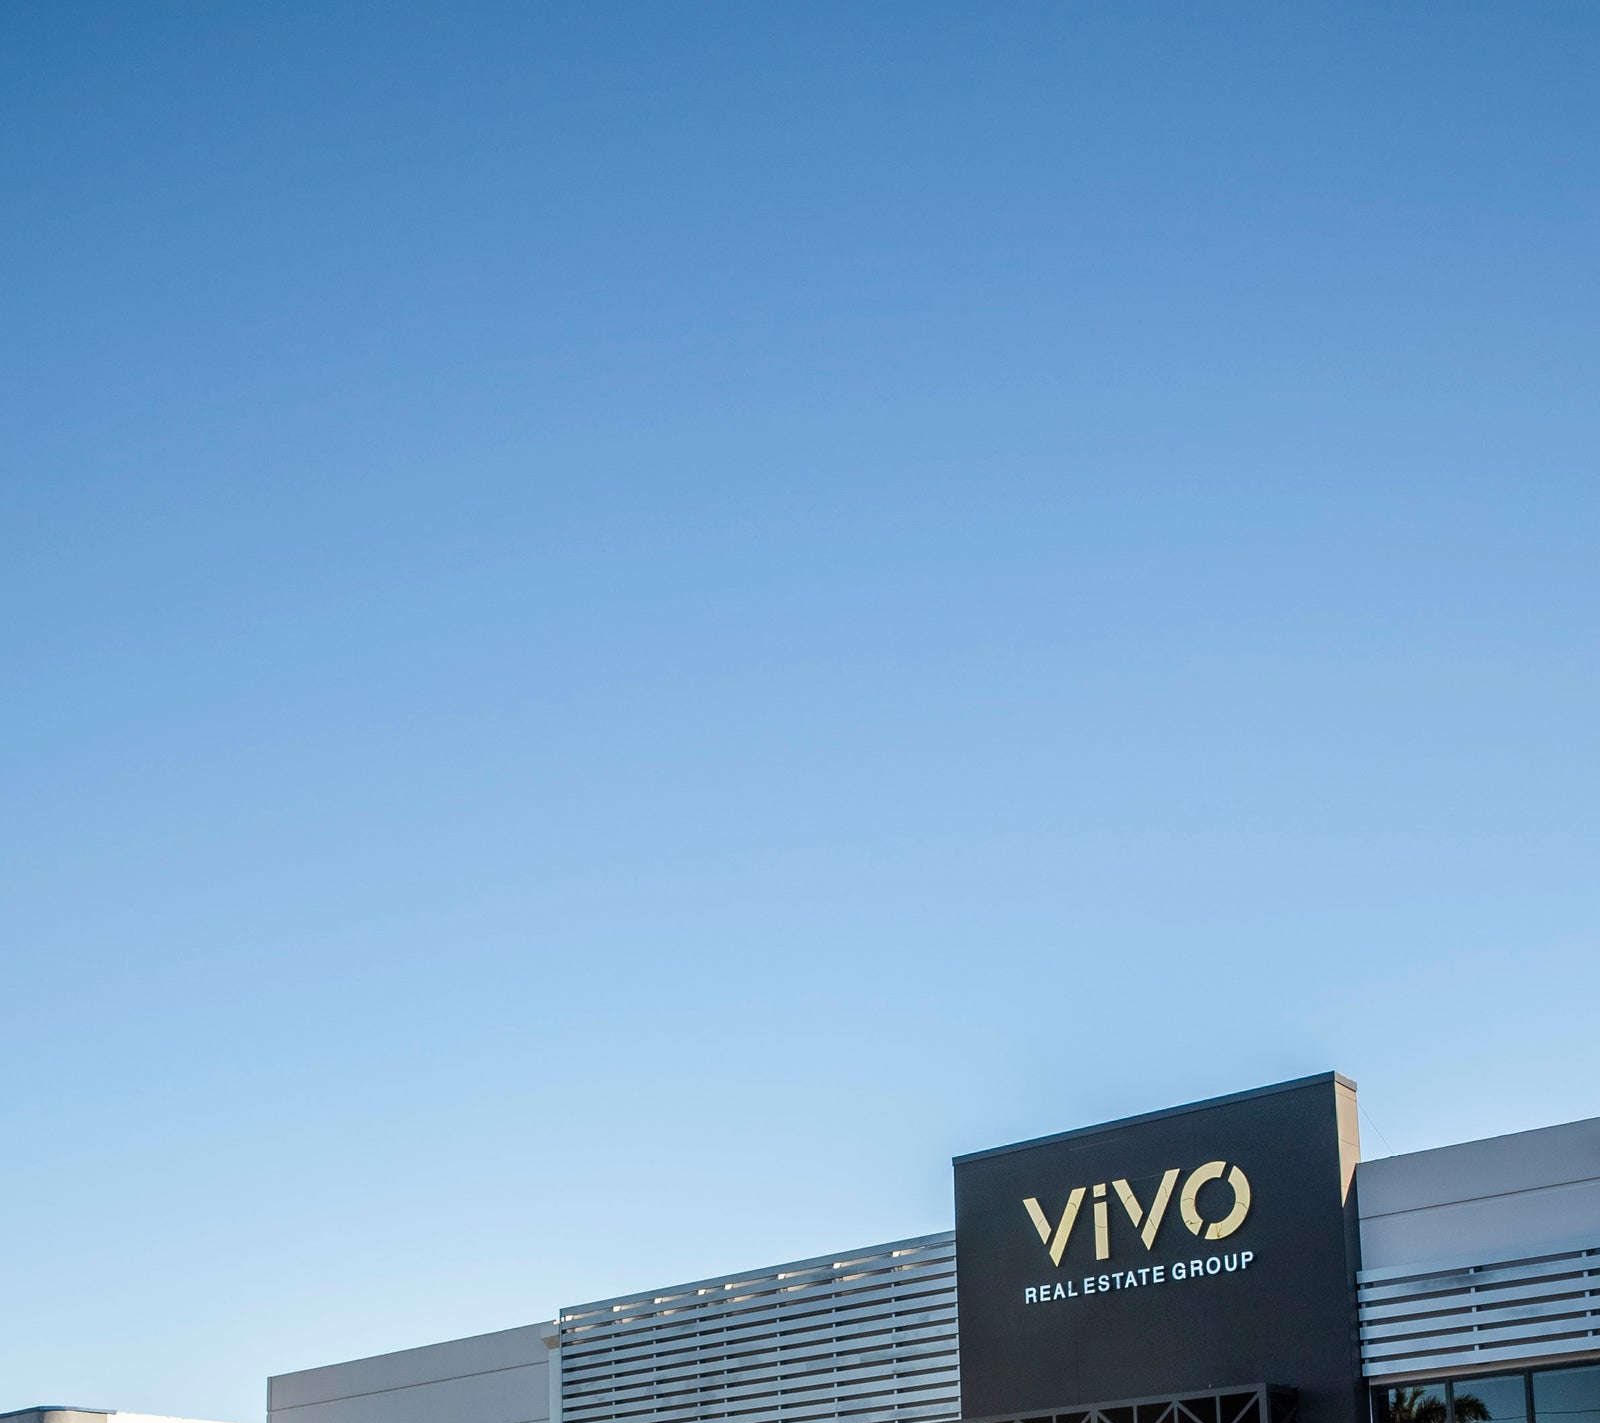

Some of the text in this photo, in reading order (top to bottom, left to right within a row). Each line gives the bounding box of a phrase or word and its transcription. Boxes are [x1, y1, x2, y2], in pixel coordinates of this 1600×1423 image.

[1025, 1251, 1255, 1304] REAL ESTATE GROUP
